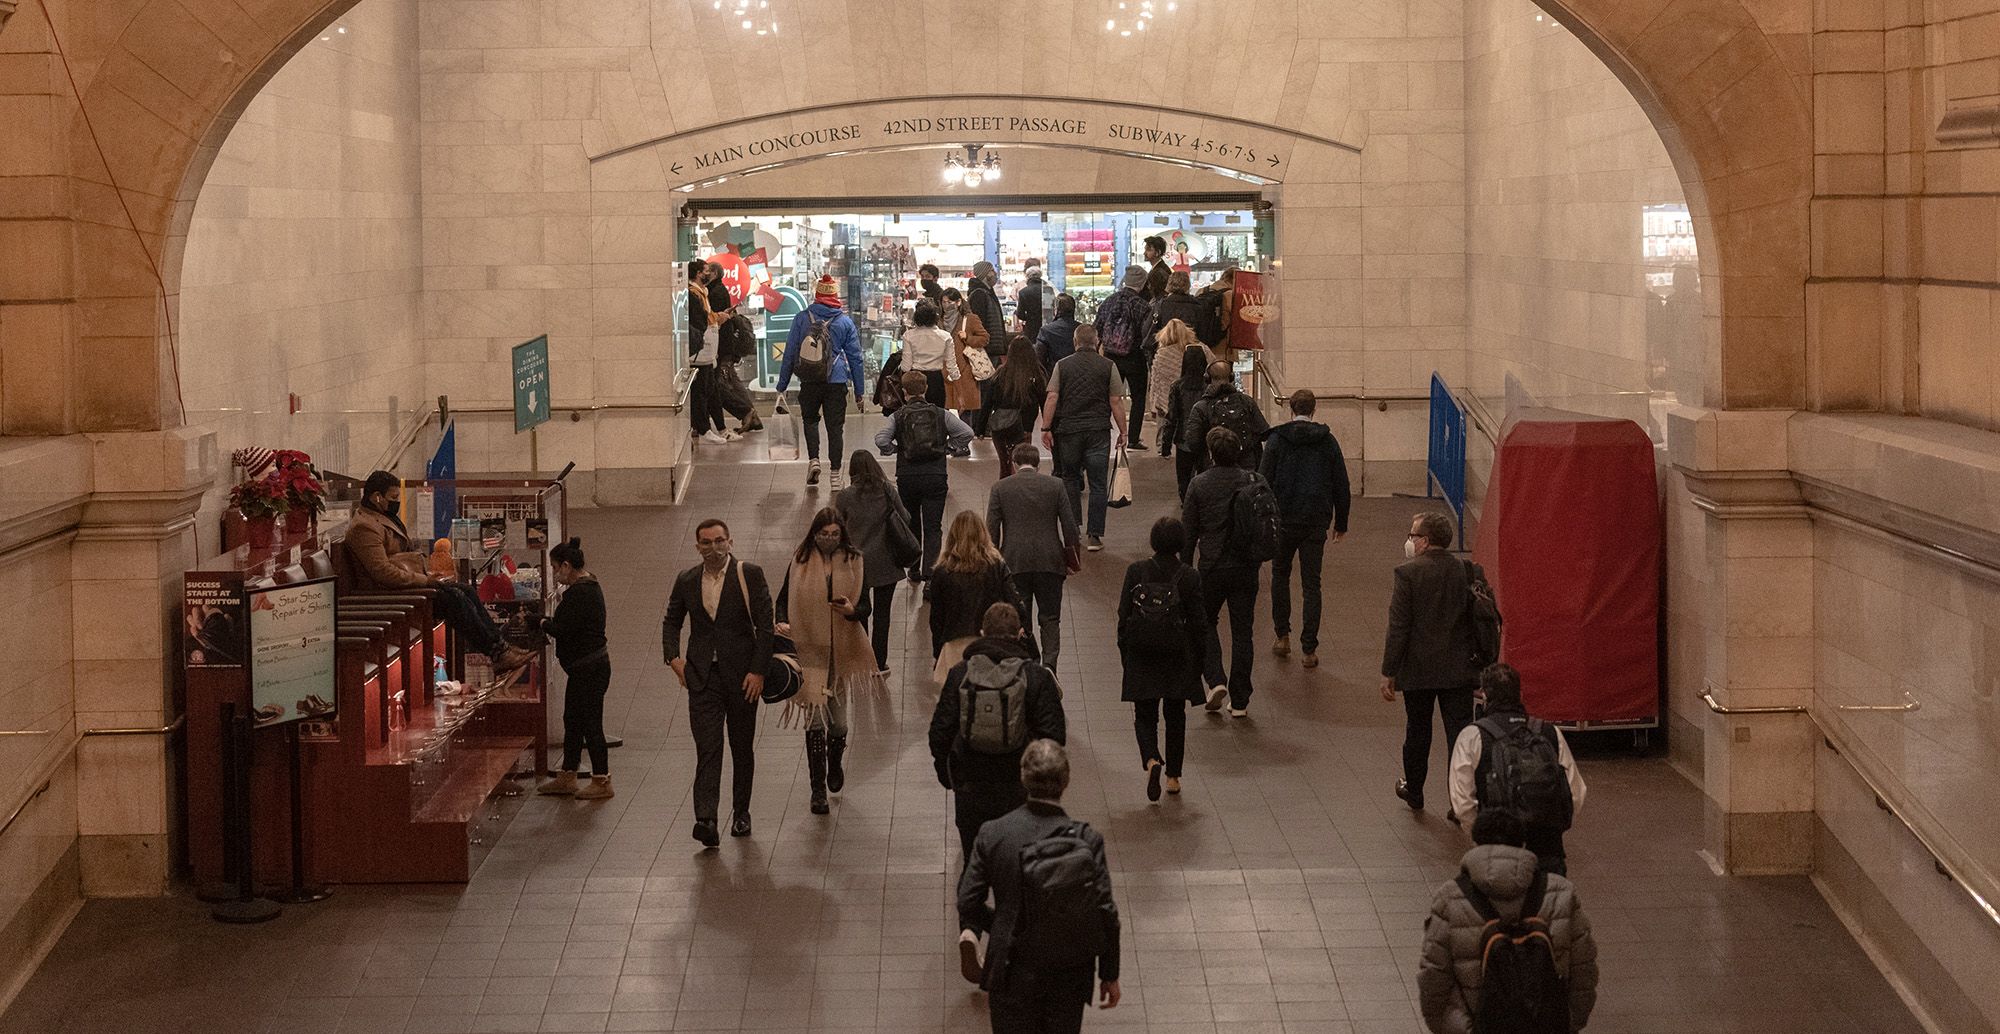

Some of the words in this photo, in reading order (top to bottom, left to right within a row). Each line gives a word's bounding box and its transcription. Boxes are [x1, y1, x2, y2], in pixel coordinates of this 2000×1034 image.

[883, 118, 931, 135] 42ND
[936, 116, 1004, 132] STREET
[1009, 117, 1087, 135] PASSAGE
[1108, 123, 1187, 148] SUBWAY
[694, 145, 744, 170] MAIN
[748, 124, 861, 156] CONCOURSE
[519, 371, 544, 390] OPEN
[186, 581, 221, 589] SUCCESS
[278, 594, 298, 607] Star
[300, 590, 322, 603] Shoe
[271, 608, 299, 621] Repair
[307, 601, 332, 614] Shine
[301, 636, 307, 648] 3
